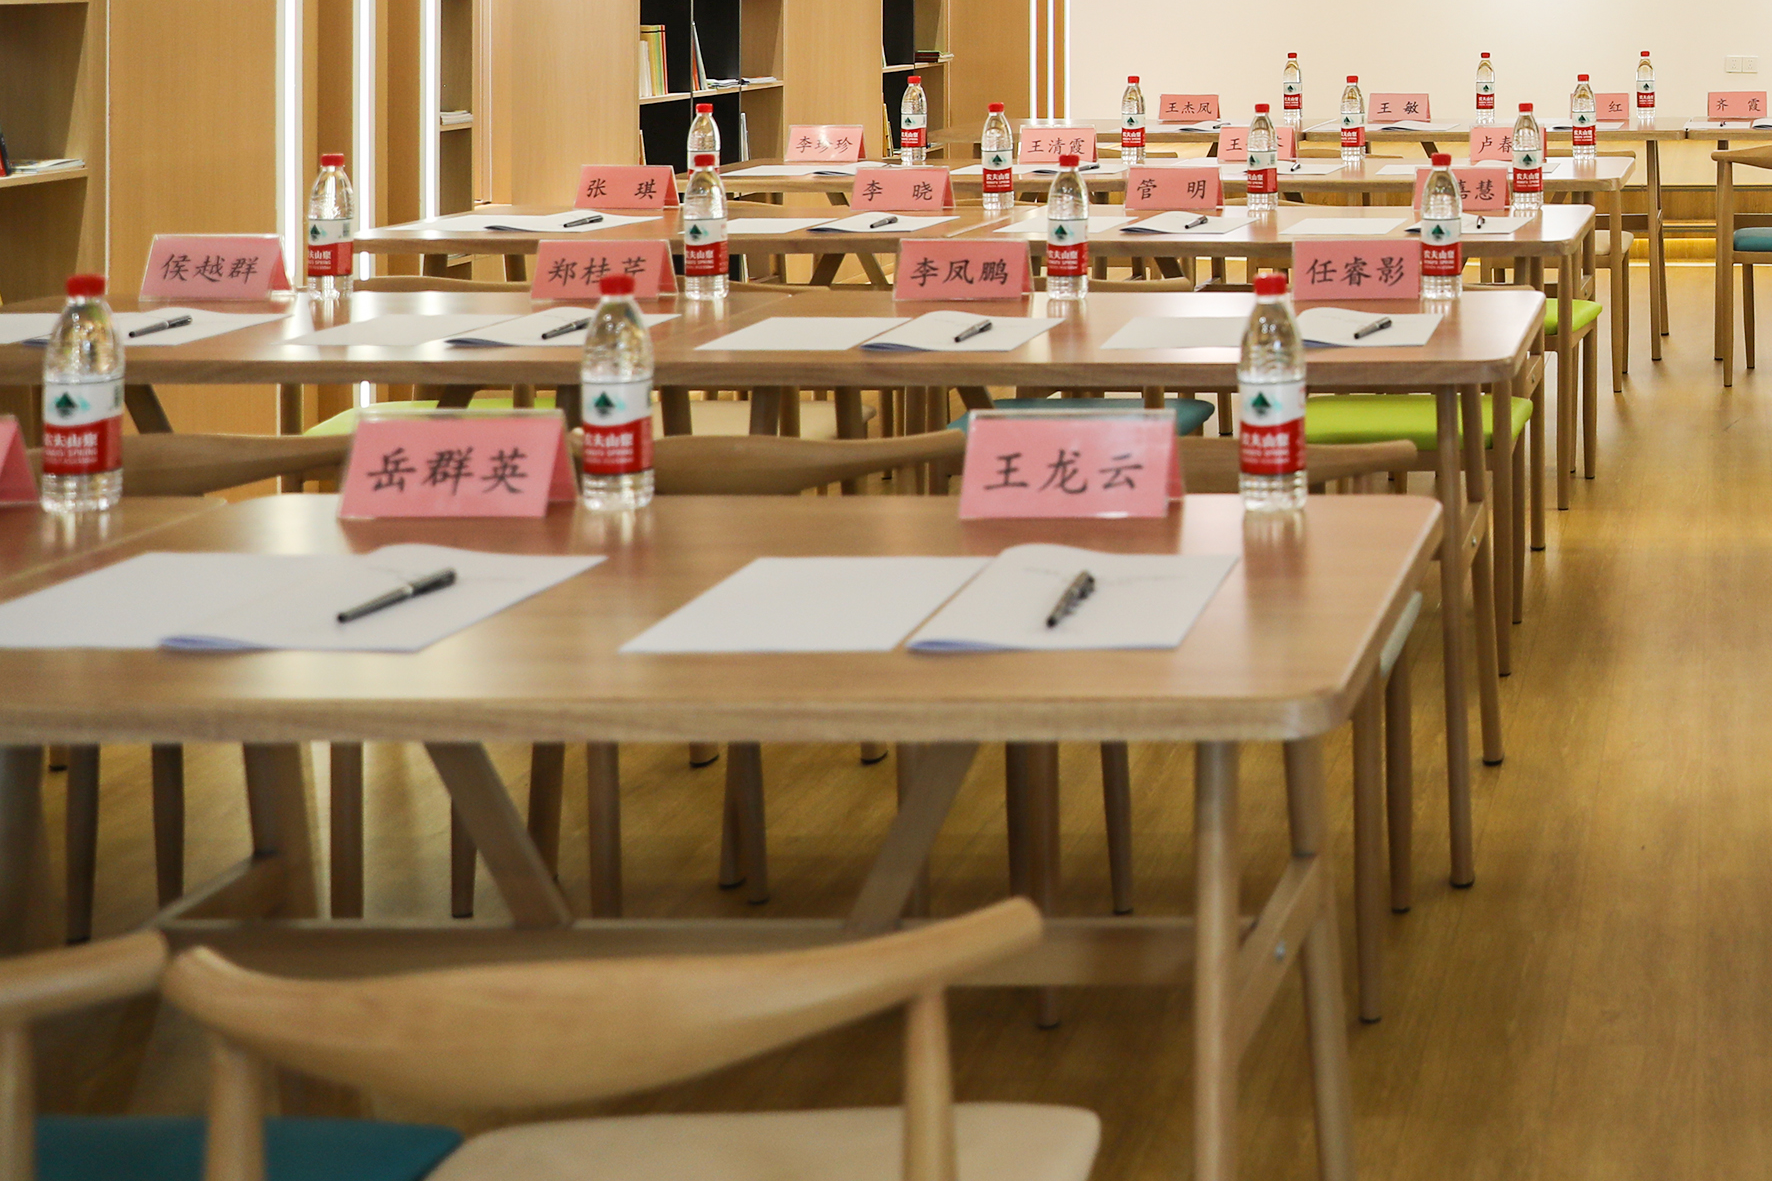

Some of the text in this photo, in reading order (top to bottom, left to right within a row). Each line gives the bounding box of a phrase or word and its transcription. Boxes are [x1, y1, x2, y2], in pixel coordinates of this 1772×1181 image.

[1165, 101, 1212, 115] 王杰凤
[1377, 101, 1419, 115] 王敏
[1606, 102, 1625, 115] 红
[1717, 98, 1761, 112] 齐霞
[796, 136, 853, 154] 李珍珍
[1028, 136, 1087, 156] 王清霞
[1477, 135, 1513, 154] 卢春
[586, 178, 657, 200] 张琪
[862, 179, 933, 202] 李晓
[1136, 178, 1207, 200] 管明
[163, 254, 259, 283] 侯越群
[910, 257, 1009, 287] 李凤鹏
[1307, 256, 1404, 287] 任睿影
[367, 447, 527, 494] 岳群英
[985, 449, 1143, 495] 王龙云
